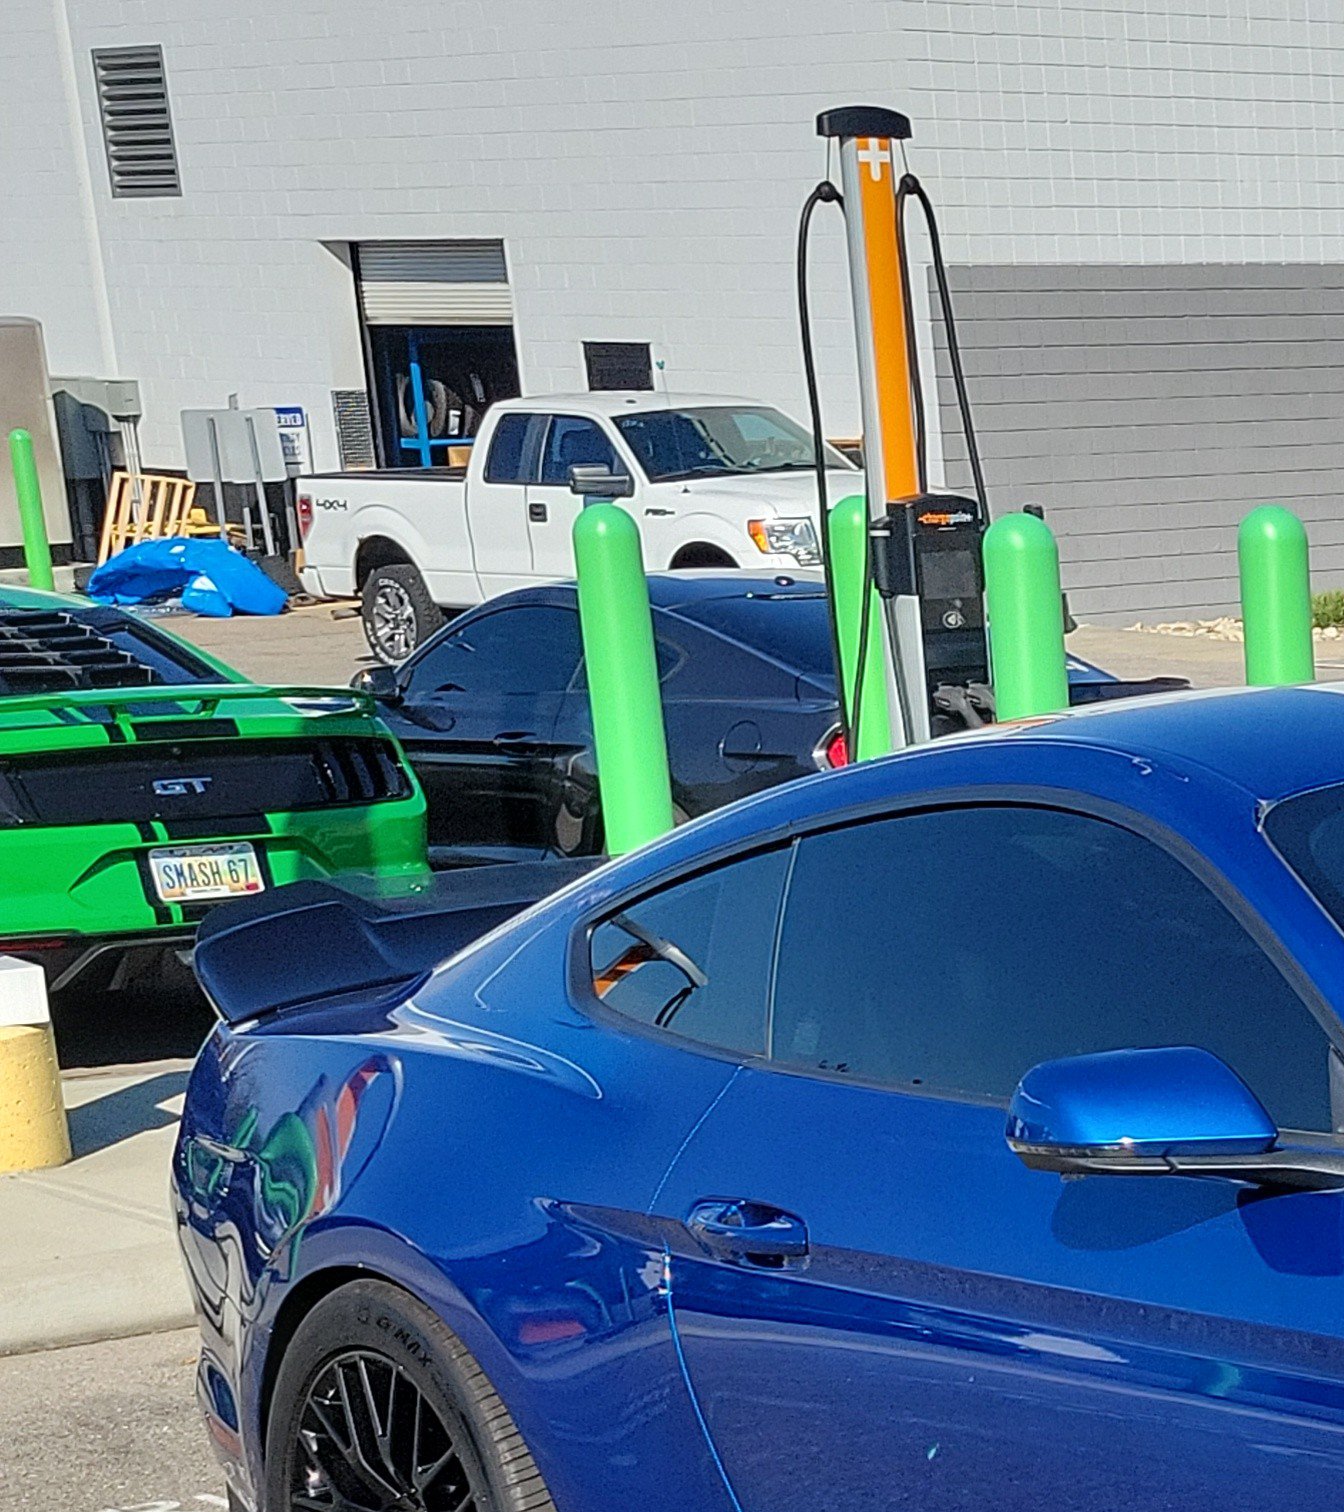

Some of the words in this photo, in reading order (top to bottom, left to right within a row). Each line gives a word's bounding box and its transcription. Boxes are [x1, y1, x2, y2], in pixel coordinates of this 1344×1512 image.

[152, 777, 212, 795] GT
[162, 860, 224, 890] SMASH
[227, 858, 250, 885] 67
